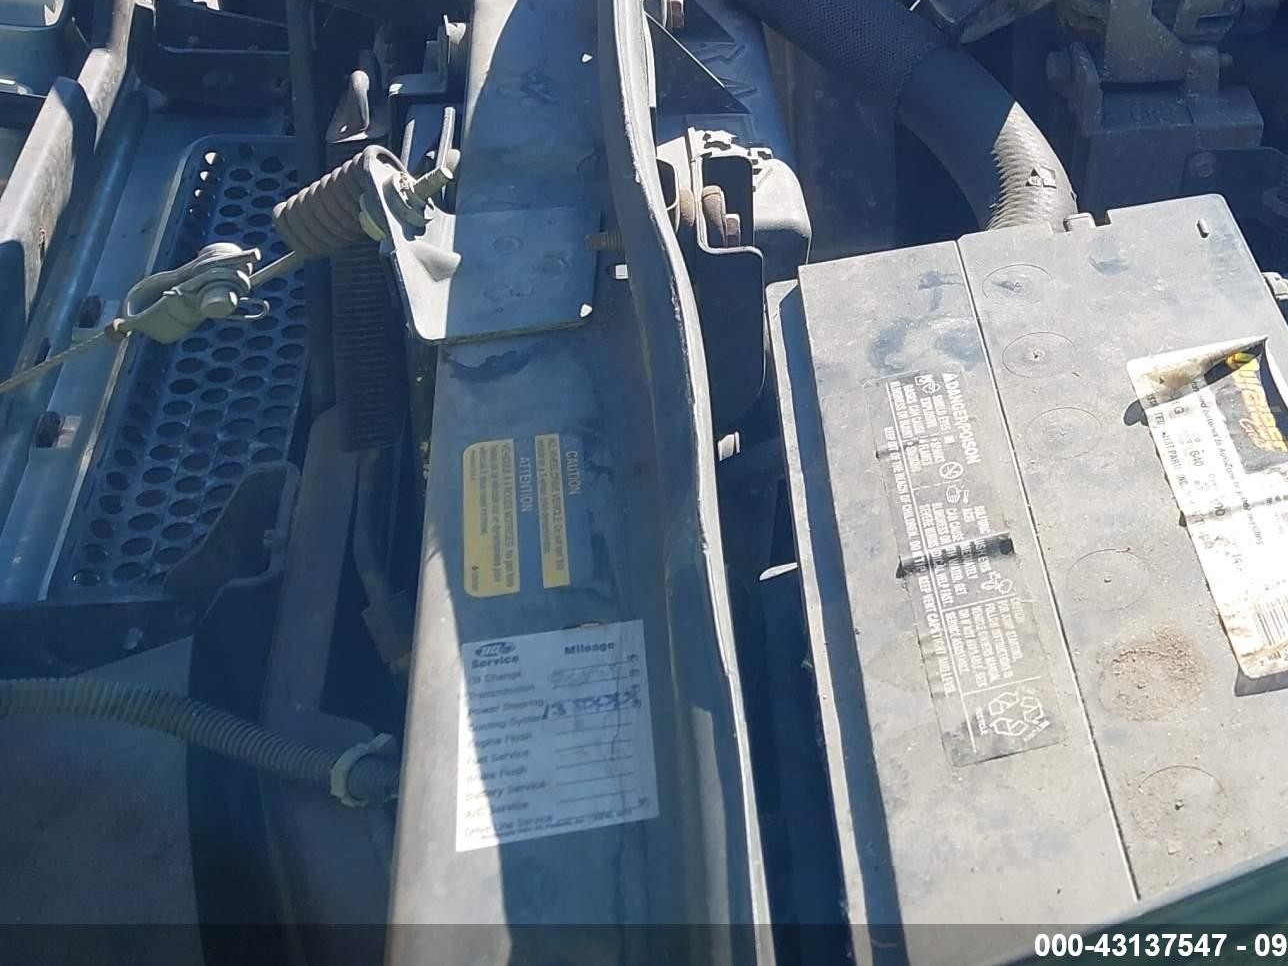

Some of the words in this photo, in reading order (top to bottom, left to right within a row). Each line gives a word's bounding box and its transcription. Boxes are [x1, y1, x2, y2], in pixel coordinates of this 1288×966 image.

[944, 380, 981, 464] DANGER/POISON
[518, 456, 533, 512] ATTENTION
[564, 450, 581, 495] CAUTION
[471, 653, 519, 669] Service
[563, 639, 614, 656] Mileage
